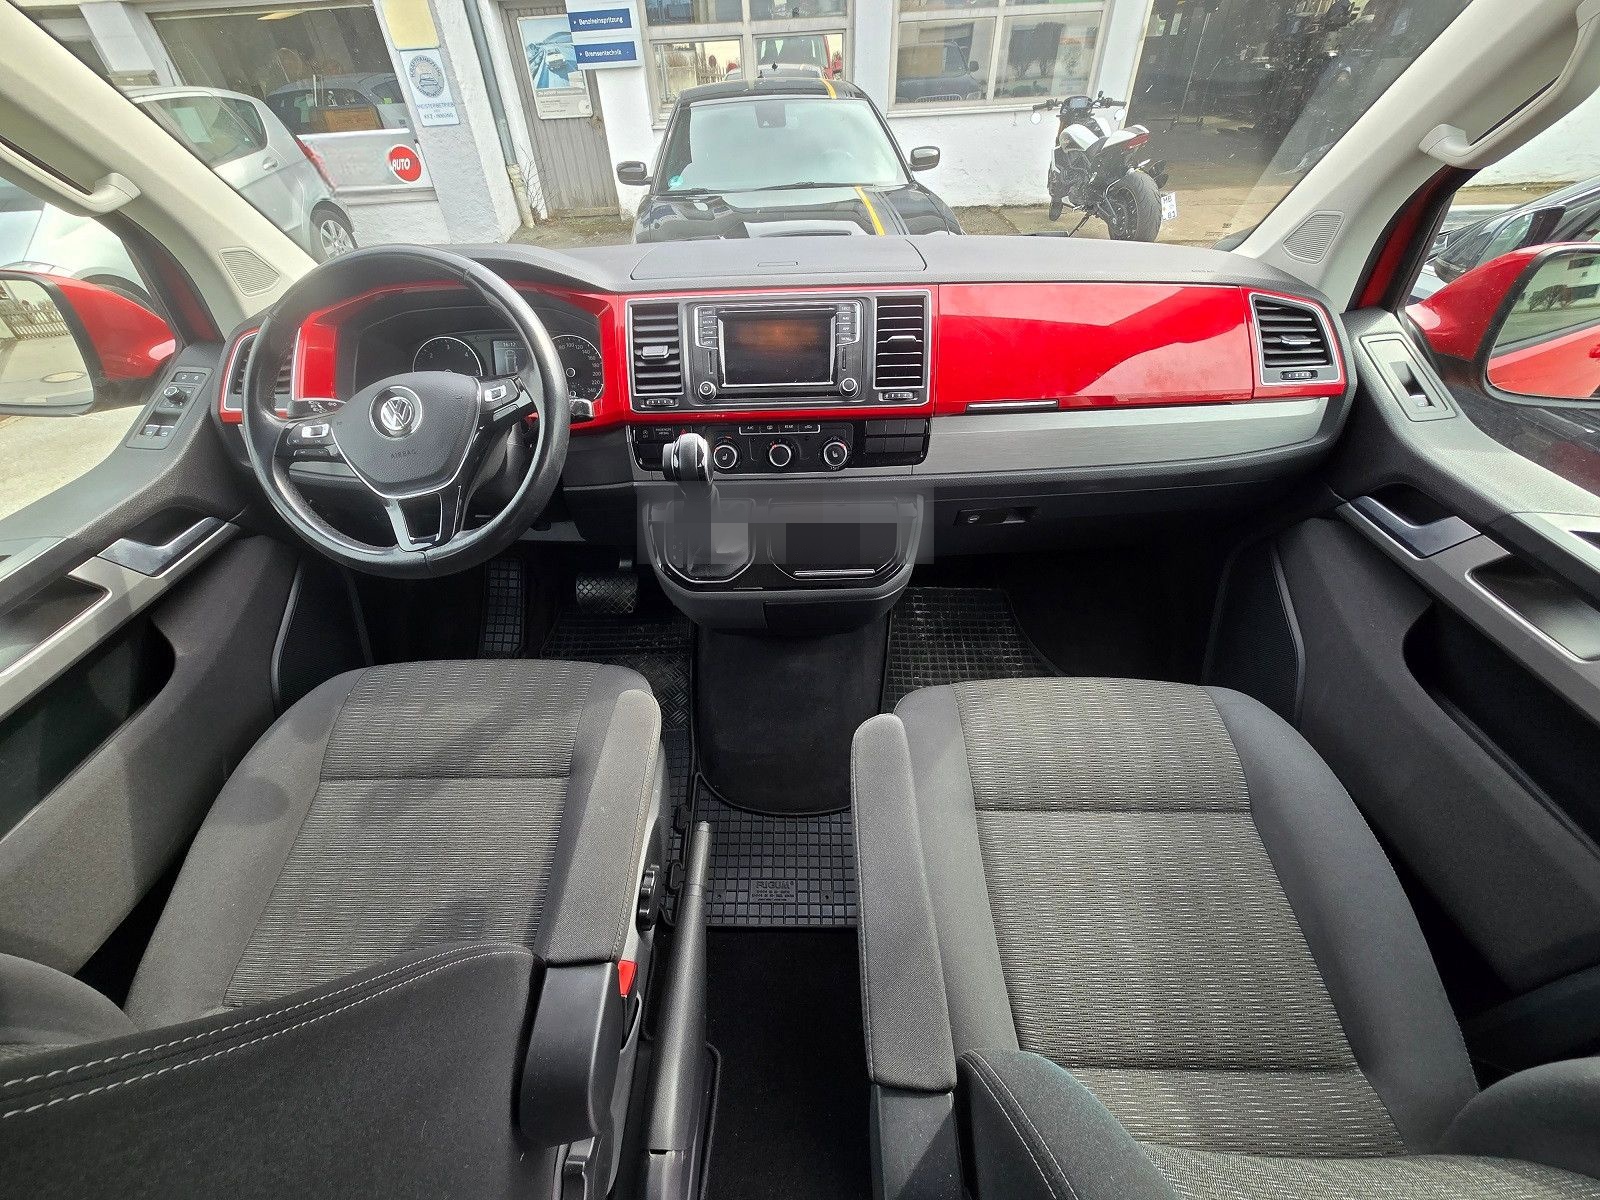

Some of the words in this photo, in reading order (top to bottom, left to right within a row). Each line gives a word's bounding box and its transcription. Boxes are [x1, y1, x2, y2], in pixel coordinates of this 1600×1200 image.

[578, 17, 624, 26] Benzineinspritzung
[584, 49, 622, 58] Bremsentechnik
[392, 157, 411, 171] AUTO
